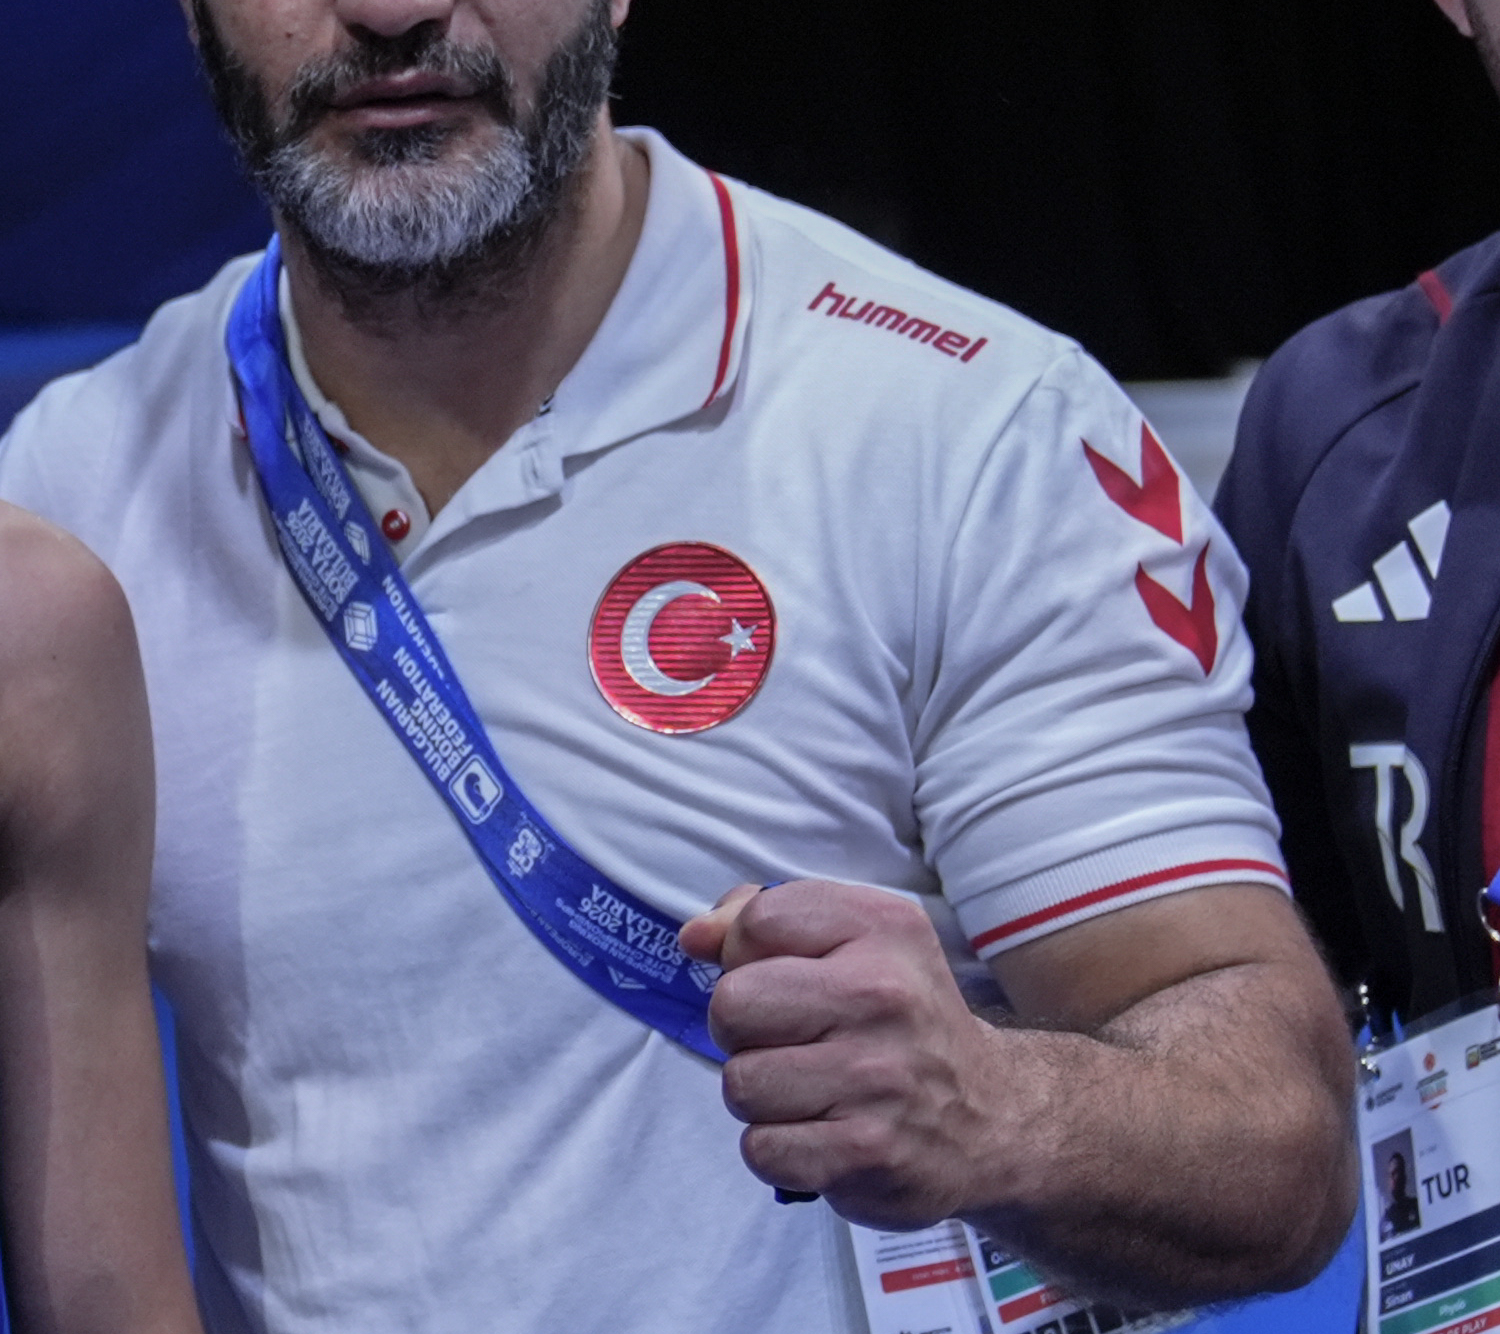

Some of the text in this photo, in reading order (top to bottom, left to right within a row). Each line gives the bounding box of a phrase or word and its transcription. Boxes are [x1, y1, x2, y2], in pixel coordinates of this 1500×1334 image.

[808, 281, 988, 364] hummel
[375, 678, 450, 782] BULGARIAN
[393, 646, 473, 757] FEDERATION
[410, 697, 463, 771] BOXING
[578, 897, 686, 965] SOFIA 2026
[592, 884, 683, 952] ULGARIA
[1421, 1163, 1471, 1204] TUR
[1462, 1317, 1487, 1334] PLAY
